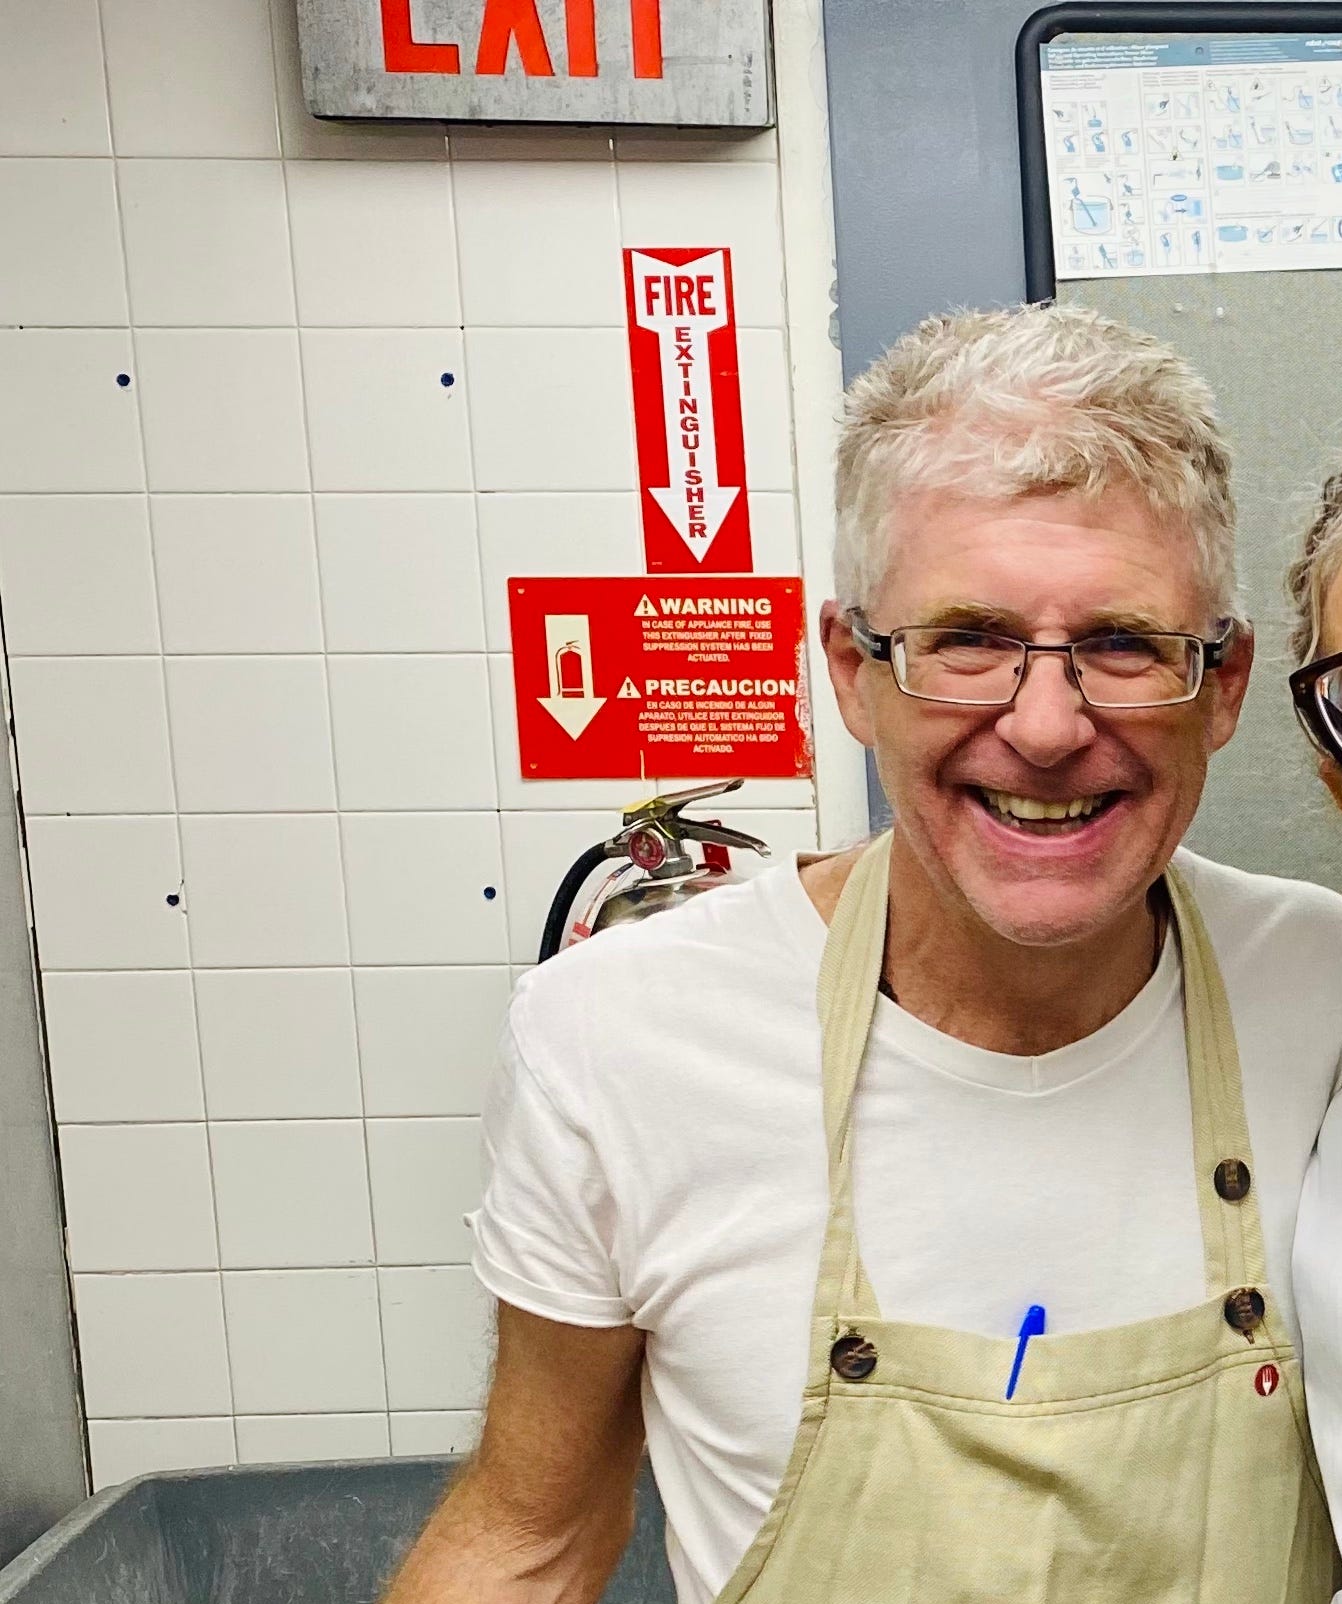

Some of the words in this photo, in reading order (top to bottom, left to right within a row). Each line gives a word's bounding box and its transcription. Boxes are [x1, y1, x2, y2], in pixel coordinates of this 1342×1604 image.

[644, 275, 717, 316] FIRE
[674, 326, 708, 538] EXTINGUISHER
[659, 598, 772, 615] WARNING
[641, 620, 651, 629] IN
[651, 620, 674, 629] CASE
[675, 620, 687, 629] OF
[687, 620, 733, 629] APPLIANCE
[733, 620, 755, 630] FIRE,
[755, 620, 772, 629] USE
[642, 631, 661, 640] THIS
[661, 631, 719, 640] EXTINGUISHER
[720, 631, 746, 640] AFTER
[749, 631, 773, 640] FIXED
[642, 642, 699, 651] SUPPRESSION
[699, 642, 732, 651] SYSTEM
[733, 642, 750, 651] HAS
[751, 642, 774, 651] BEEN
[687, 653, 731, 663] ACTUATED.
[645, 679, 796, 696] PRECAUCION
[646, 700, 658, 709] EN
[658, 700, 682, 709] CASO
[683, 700, 695, 709] DE
[695, 700, 734, 710] INCENDIO
[734, 700, 746, 709] DE
[747, 700, 776, 710] ALGUN
[638, 711, 677, 721] APARATO,
[677, 711, 709, 720] UTILICE
[709, 711, 730, 720] ESTE
[731, 711, 785, 721] EXTINGUIDOR
[638, 722, 676, 731] DESPUES
[676, 722, 689, 731] DE
[689, 722, 707, 731] QUE
[707, 722, 719, 731] EL
[719, 722, 754, 731] SISTEMA
[755, 722, 774, 731] FIJO
[774, 722, 786, 731] DE
[694, 733, 746, 743] AUTOMATICO
[746, 733, 758, 742] HA
[758, 733, 779, 742] SIDO
[692, 744, 735, 753] ACTIVADO.
